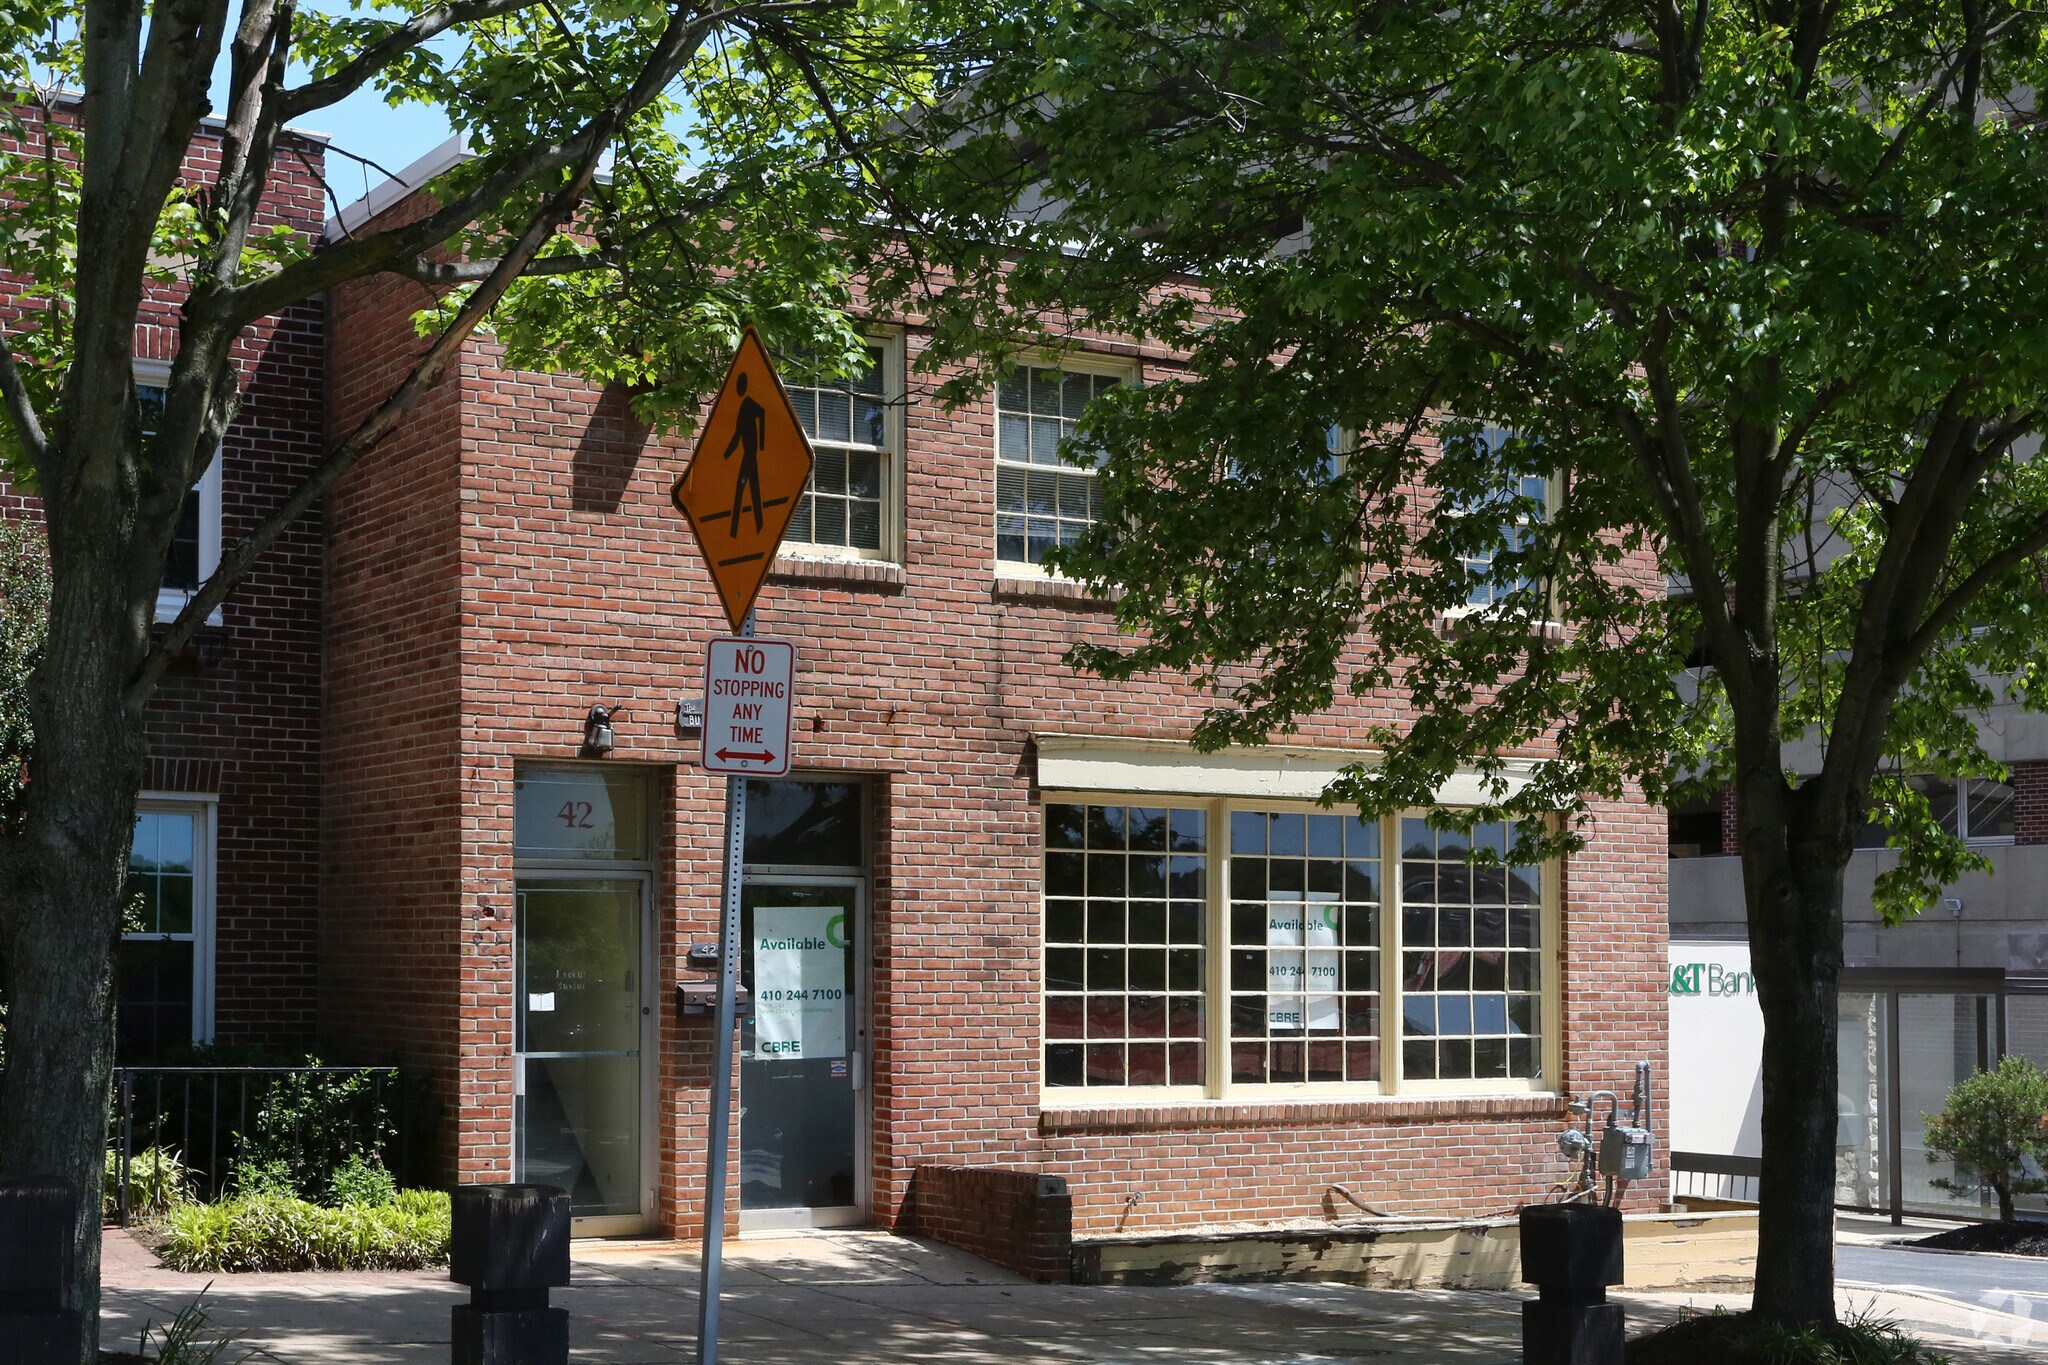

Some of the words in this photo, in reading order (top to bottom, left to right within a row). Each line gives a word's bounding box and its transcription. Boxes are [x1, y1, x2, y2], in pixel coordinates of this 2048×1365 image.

[735, 649, 765, 674] NO
[713, 679, 784, 699] STOPPING
[732, 703, 762, 720] ANY
[730, 725, 763, 744] TIME
[557, 800, 594, 829] 42
[1269, 918, 1324, 931] Available
[760, 937, 826, 951] Available
[1269, 966, 1287, 976] 410
[1311, 967, 1336, 977] 7100
[1666, 963, 1706, 993] &T
[760, 990, 782, 1001] 410
[786, 989, 808, 1001] 244
[812, 989, 842, 1001] 7100
[1269, 1012, 1300, 1023] CBRE
[761, 1040, 800, 1053] CBRE
